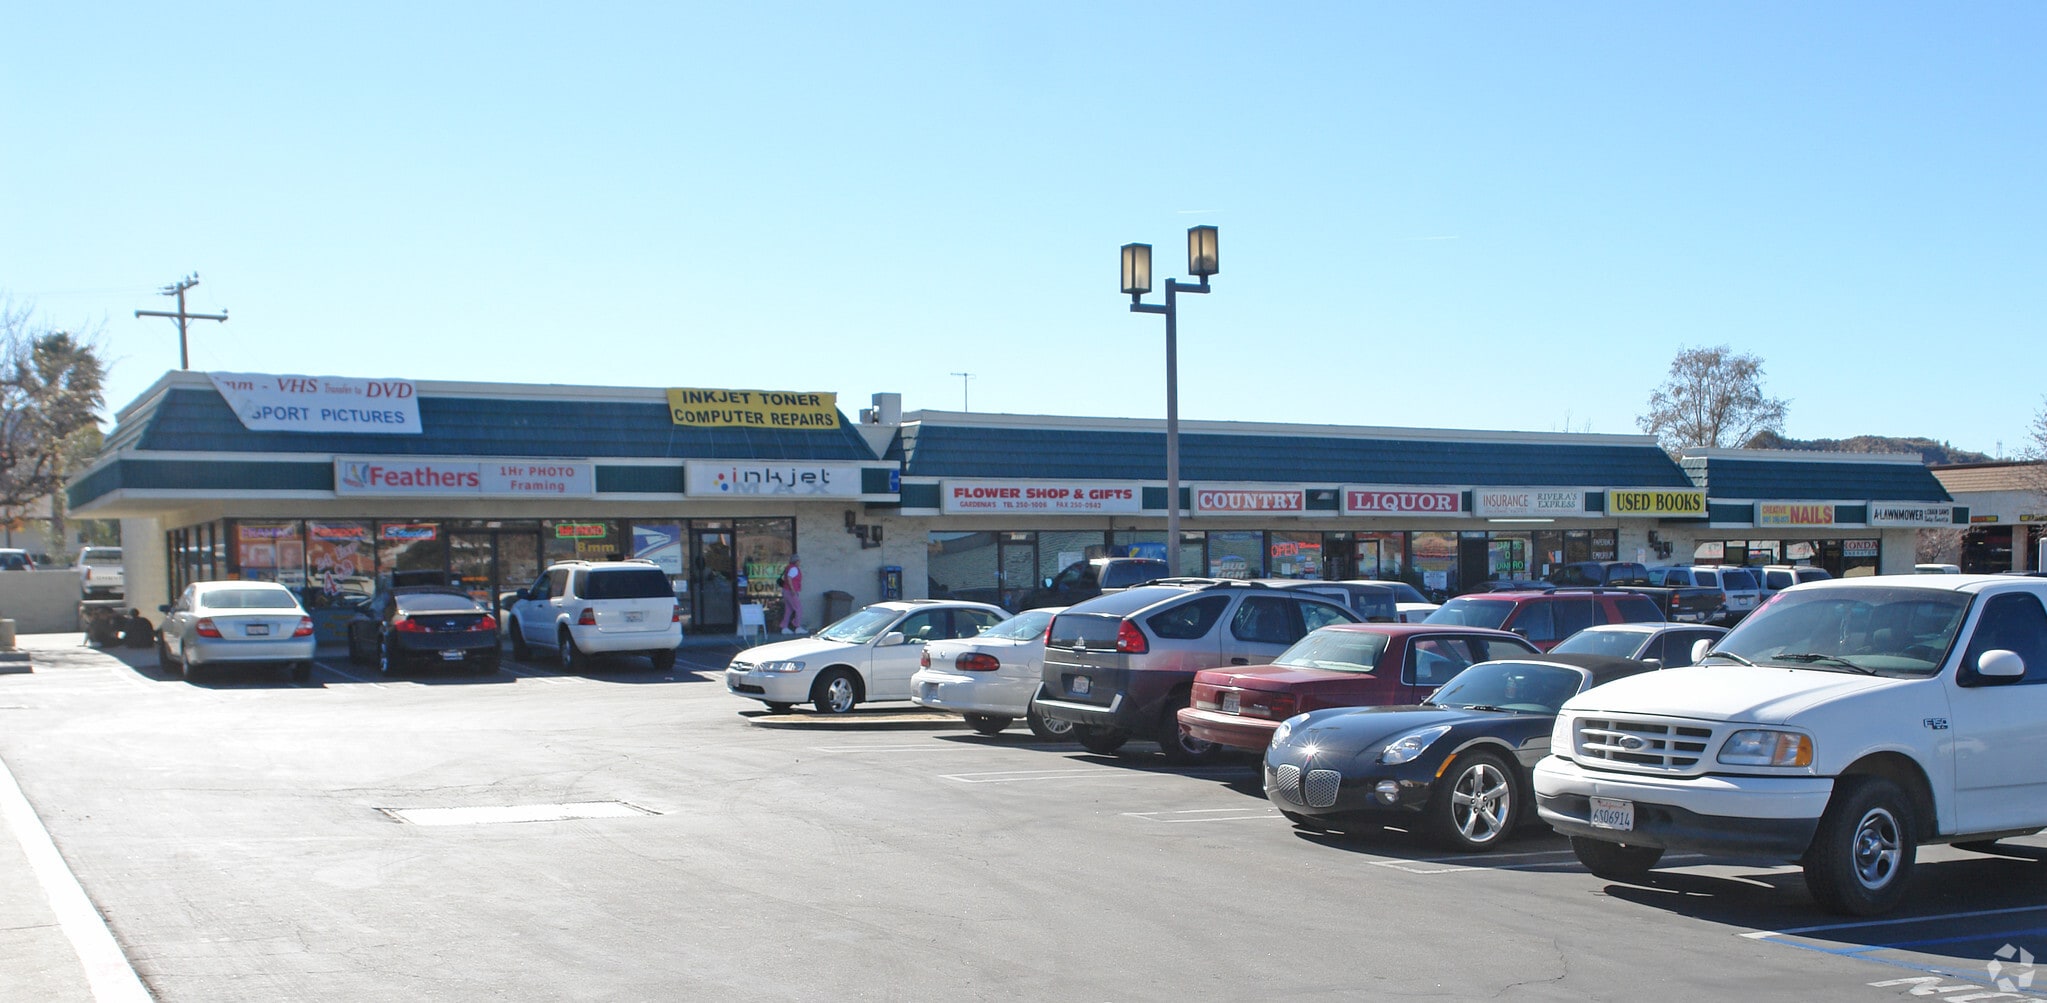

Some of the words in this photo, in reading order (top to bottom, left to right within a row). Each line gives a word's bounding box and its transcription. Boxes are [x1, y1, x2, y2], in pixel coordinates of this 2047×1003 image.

[276, 378, 318, 393] VHS
[366, 381, 413, 399] DVD
[682, 390, 751, 404] INKJET
[759, 393, 821, 406] TONER
[321, 408, 406, 424] PICTURES
[674, 408, 764, 424] COMPUTER
[771, 412, 834, 426] REPAIRS
[370, 466, 480, 487] Feathers
[500, 466, 523, 476] 1Hr
[529, 466, 575, 477] PHOTO
[732, 467, 831, 487] inkjet
[510, 480, 566, 493] Framing
[733, 481, 830, 495] MAX
[954, 487, 1021, 499] FLOWER
[1026, 488, 1070, 499] SHOP
[1073, 489, 1084, 499] &
[1088, 489, 1133, 500] GIFTS
[1200, 492, 1300, 510] COUNTRY
[1355, 493, 1452, 512] LIQUOR
[1483, 494, 1530, 508] INSURANCE
[1536, 491, 1578, 501] RIVERA'S
[1616, 493, 1650, 511] USED
[1656, 493, 1701, 512] BOOKS
[1003, 501, 1012, 509] TEL
[1537, 500, 1577, 509] EXPRESS
[1790, 504, 1833, 524] NAILS
[1270, 544, 1299, 558] OPEN
[1593, 808, 1631, 827] 6S06914
